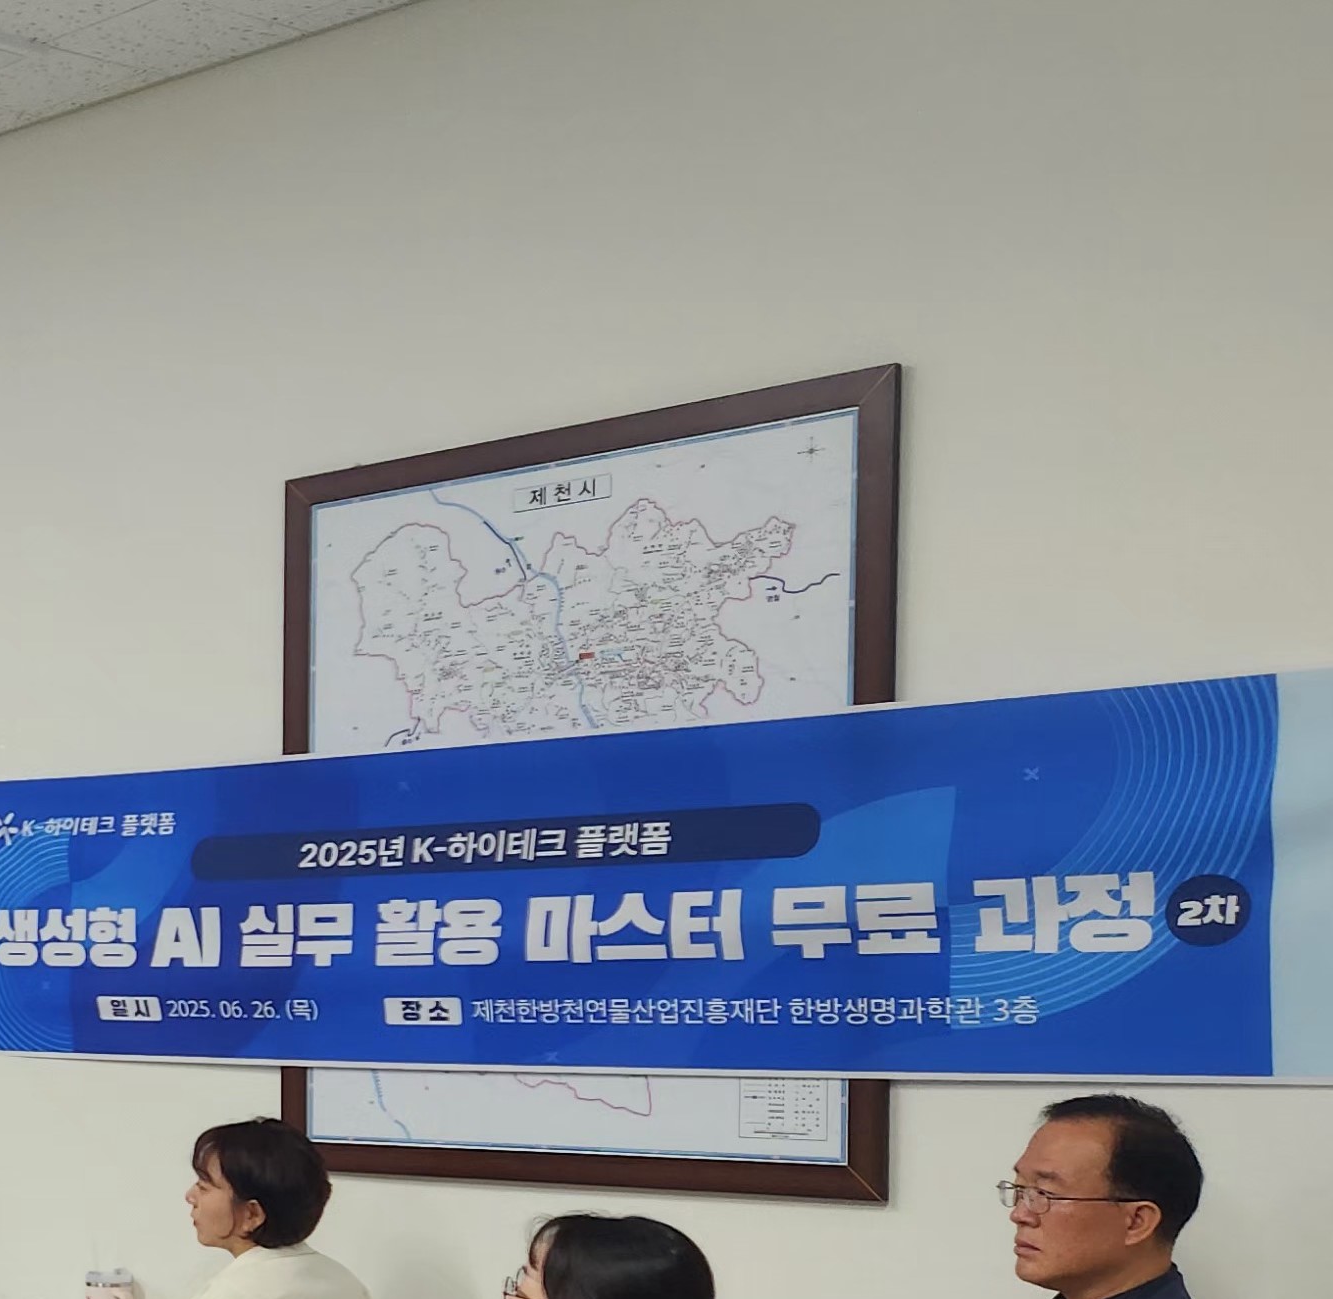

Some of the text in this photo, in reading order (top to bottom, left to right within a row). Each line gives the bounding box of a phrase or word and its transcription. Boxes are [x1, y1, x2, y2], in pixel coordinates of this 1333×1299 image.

[529, 478, 596, 505] 제천시
[21, 812, 177, 838] K-하이테크 플랫폼
[298, 821, 672, 869] 2025년 K-하이테크 플랫폼
[150, 906, 222, 968] AI
[239, 903, 354, 967] 실무
[375, 898, 503, 967] 활용
[524, 888, 745, 963] 마스터
[771, 882, 941, 960] 무료
[972, 871, 1156, 954] 과정
[1176, 894, 1240, 928] 2차
[167, 1000, 216, 1019] 2025.
[221, 1000, 248, 1019] 06.
[251, 1000, 281, 1020] 26.
[285, 999, 319, 1021] (목)
[472, 998, 781, 1025] 제천한방천연물산업진흥재단
[790, 998, 983, 1025] 한방생명과학관
[993, 996, 1040, 1025] 3층
